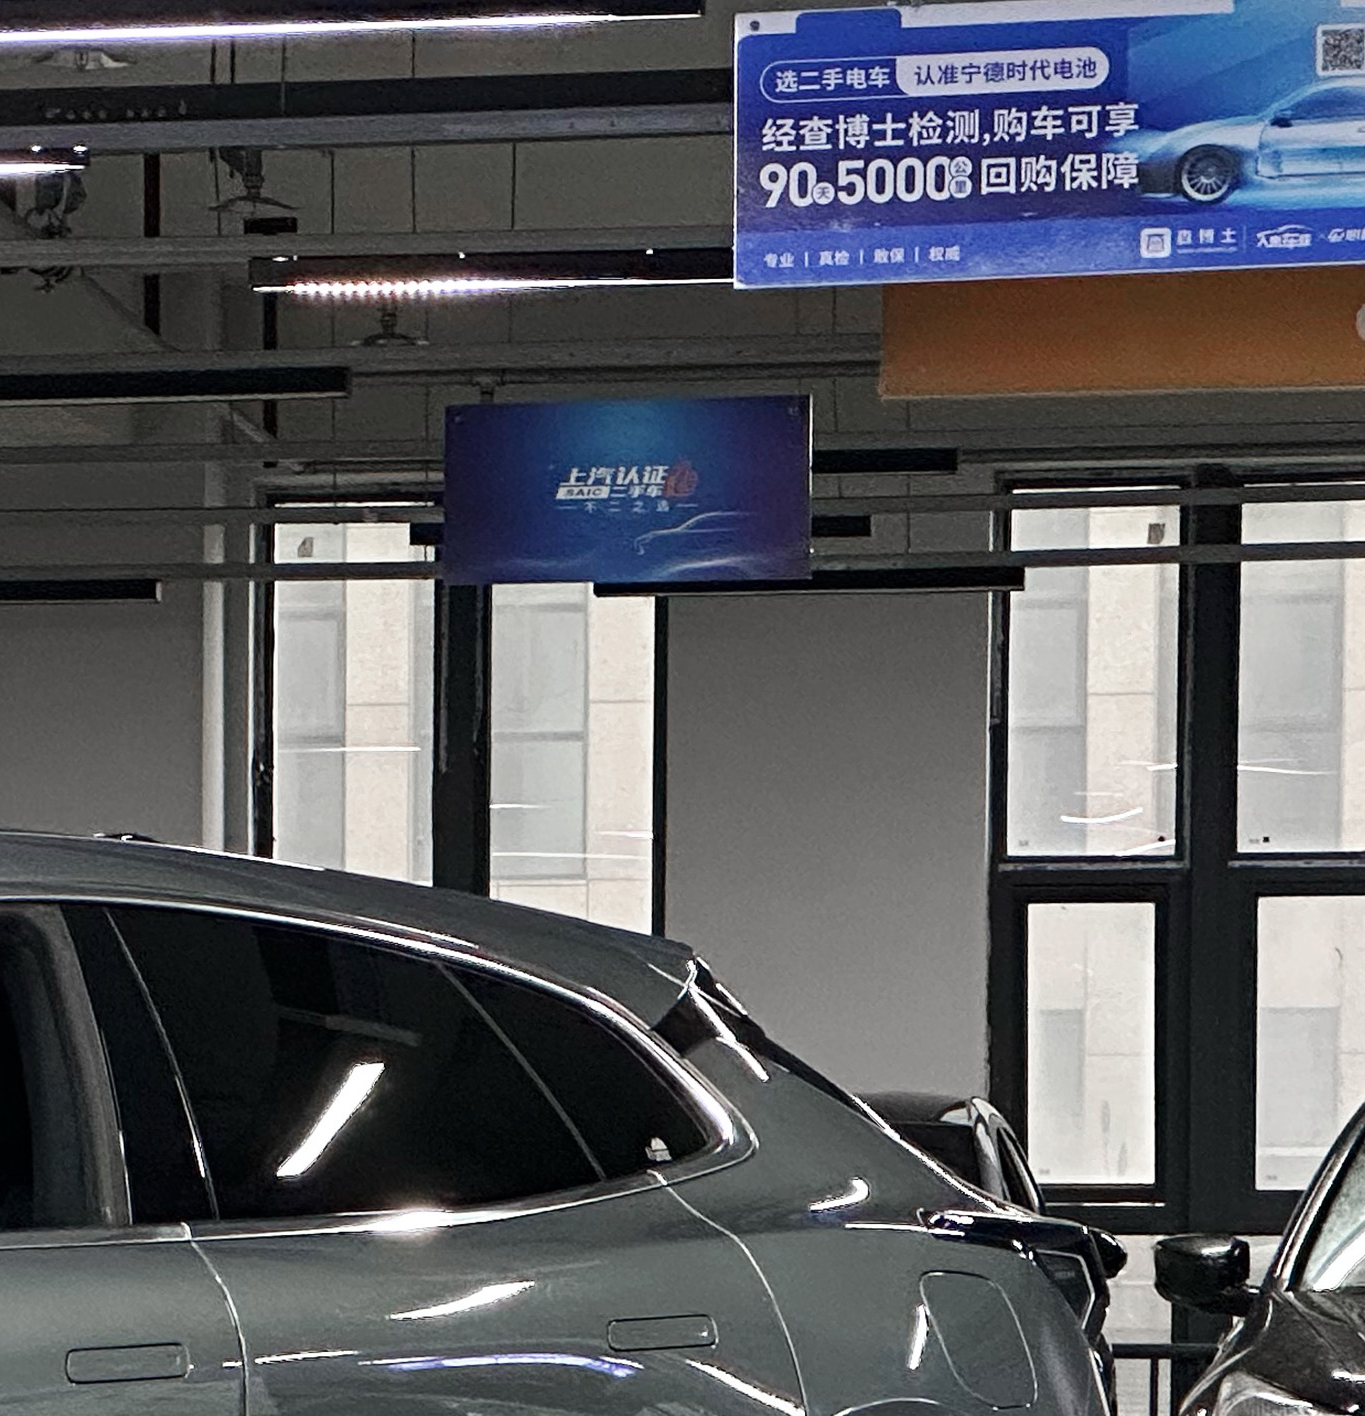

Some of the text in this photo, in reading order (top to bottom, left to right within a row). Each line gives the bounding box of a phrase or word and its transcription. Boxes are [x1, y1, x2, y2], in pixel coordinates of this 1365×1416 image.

[774, 57, 1098, 93] 选二手电车 认准宁德时代电池
[559, 465, 669, 486] 上汽认证
[564, 488, 603, 497] SAIC
